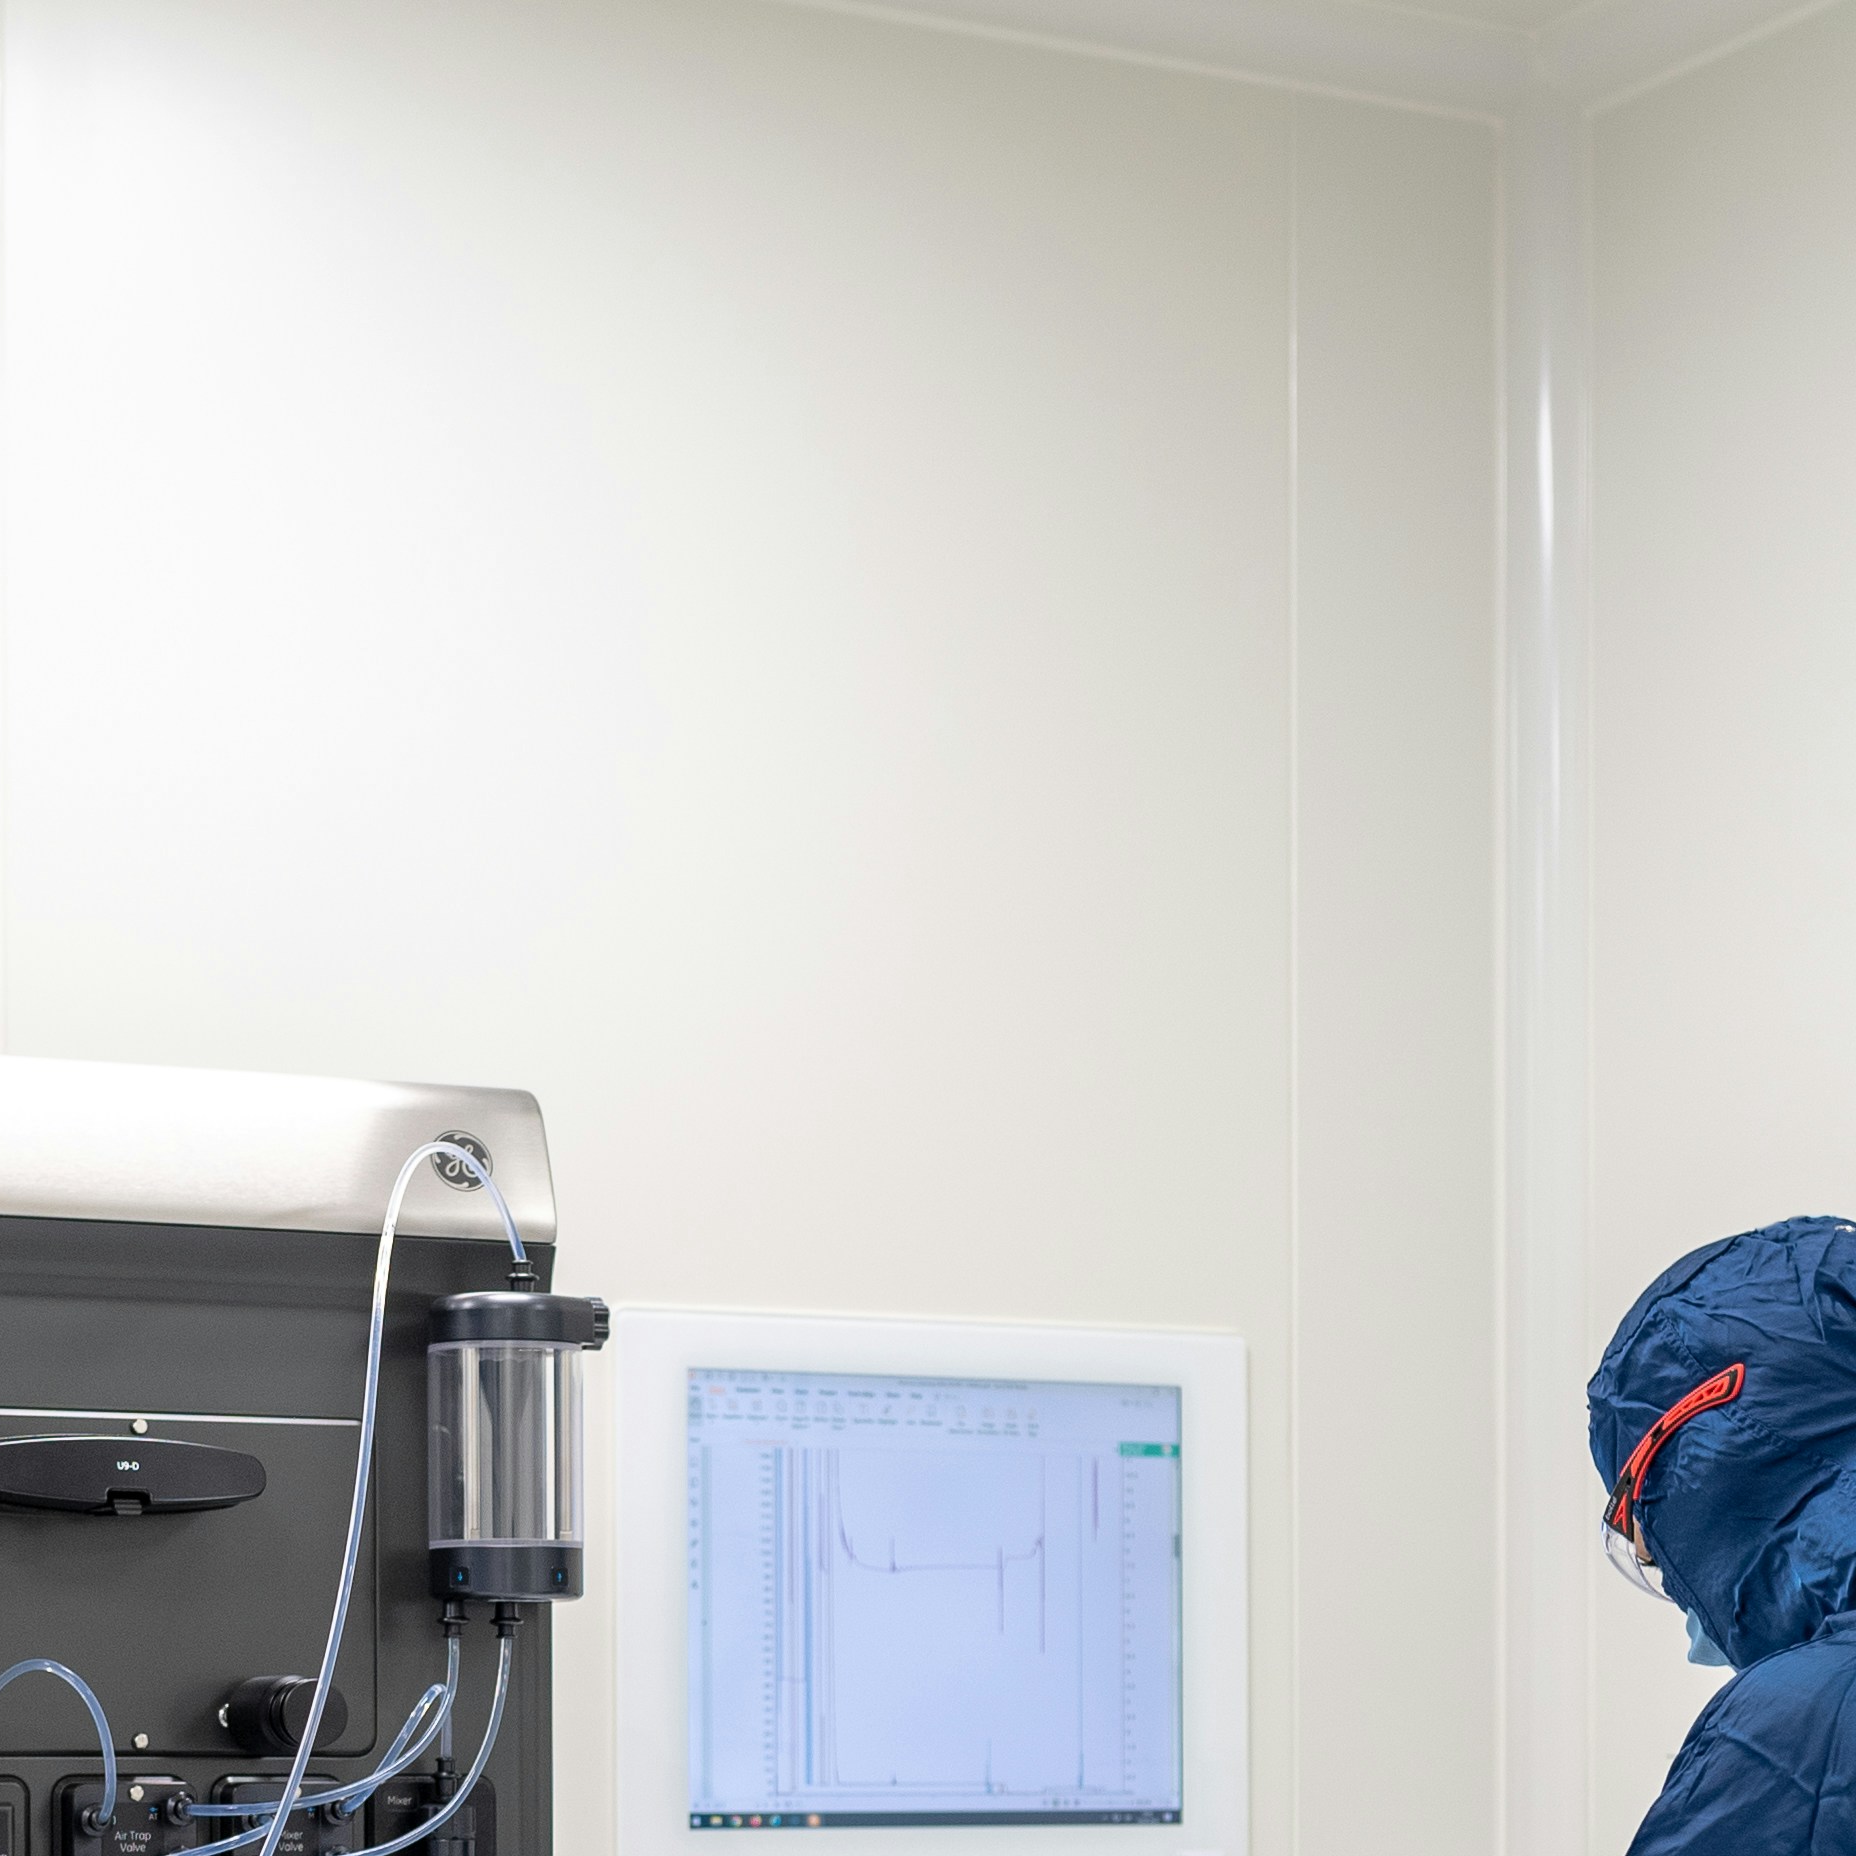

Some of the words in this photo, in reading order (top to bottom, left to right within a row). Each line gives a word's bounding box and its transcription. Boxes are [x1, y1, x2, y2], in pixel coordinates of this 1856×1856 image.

[116, 1460, 140, 1471] U9-D
[387, 1795, 412, 1806] Mixer
[114, 1831, 128, 1841] Air
[130, 1831, 152, 1842] Trap
[120, 1842, 147, 1853] Valve
[278, 1842, 304, 1852] Valve
